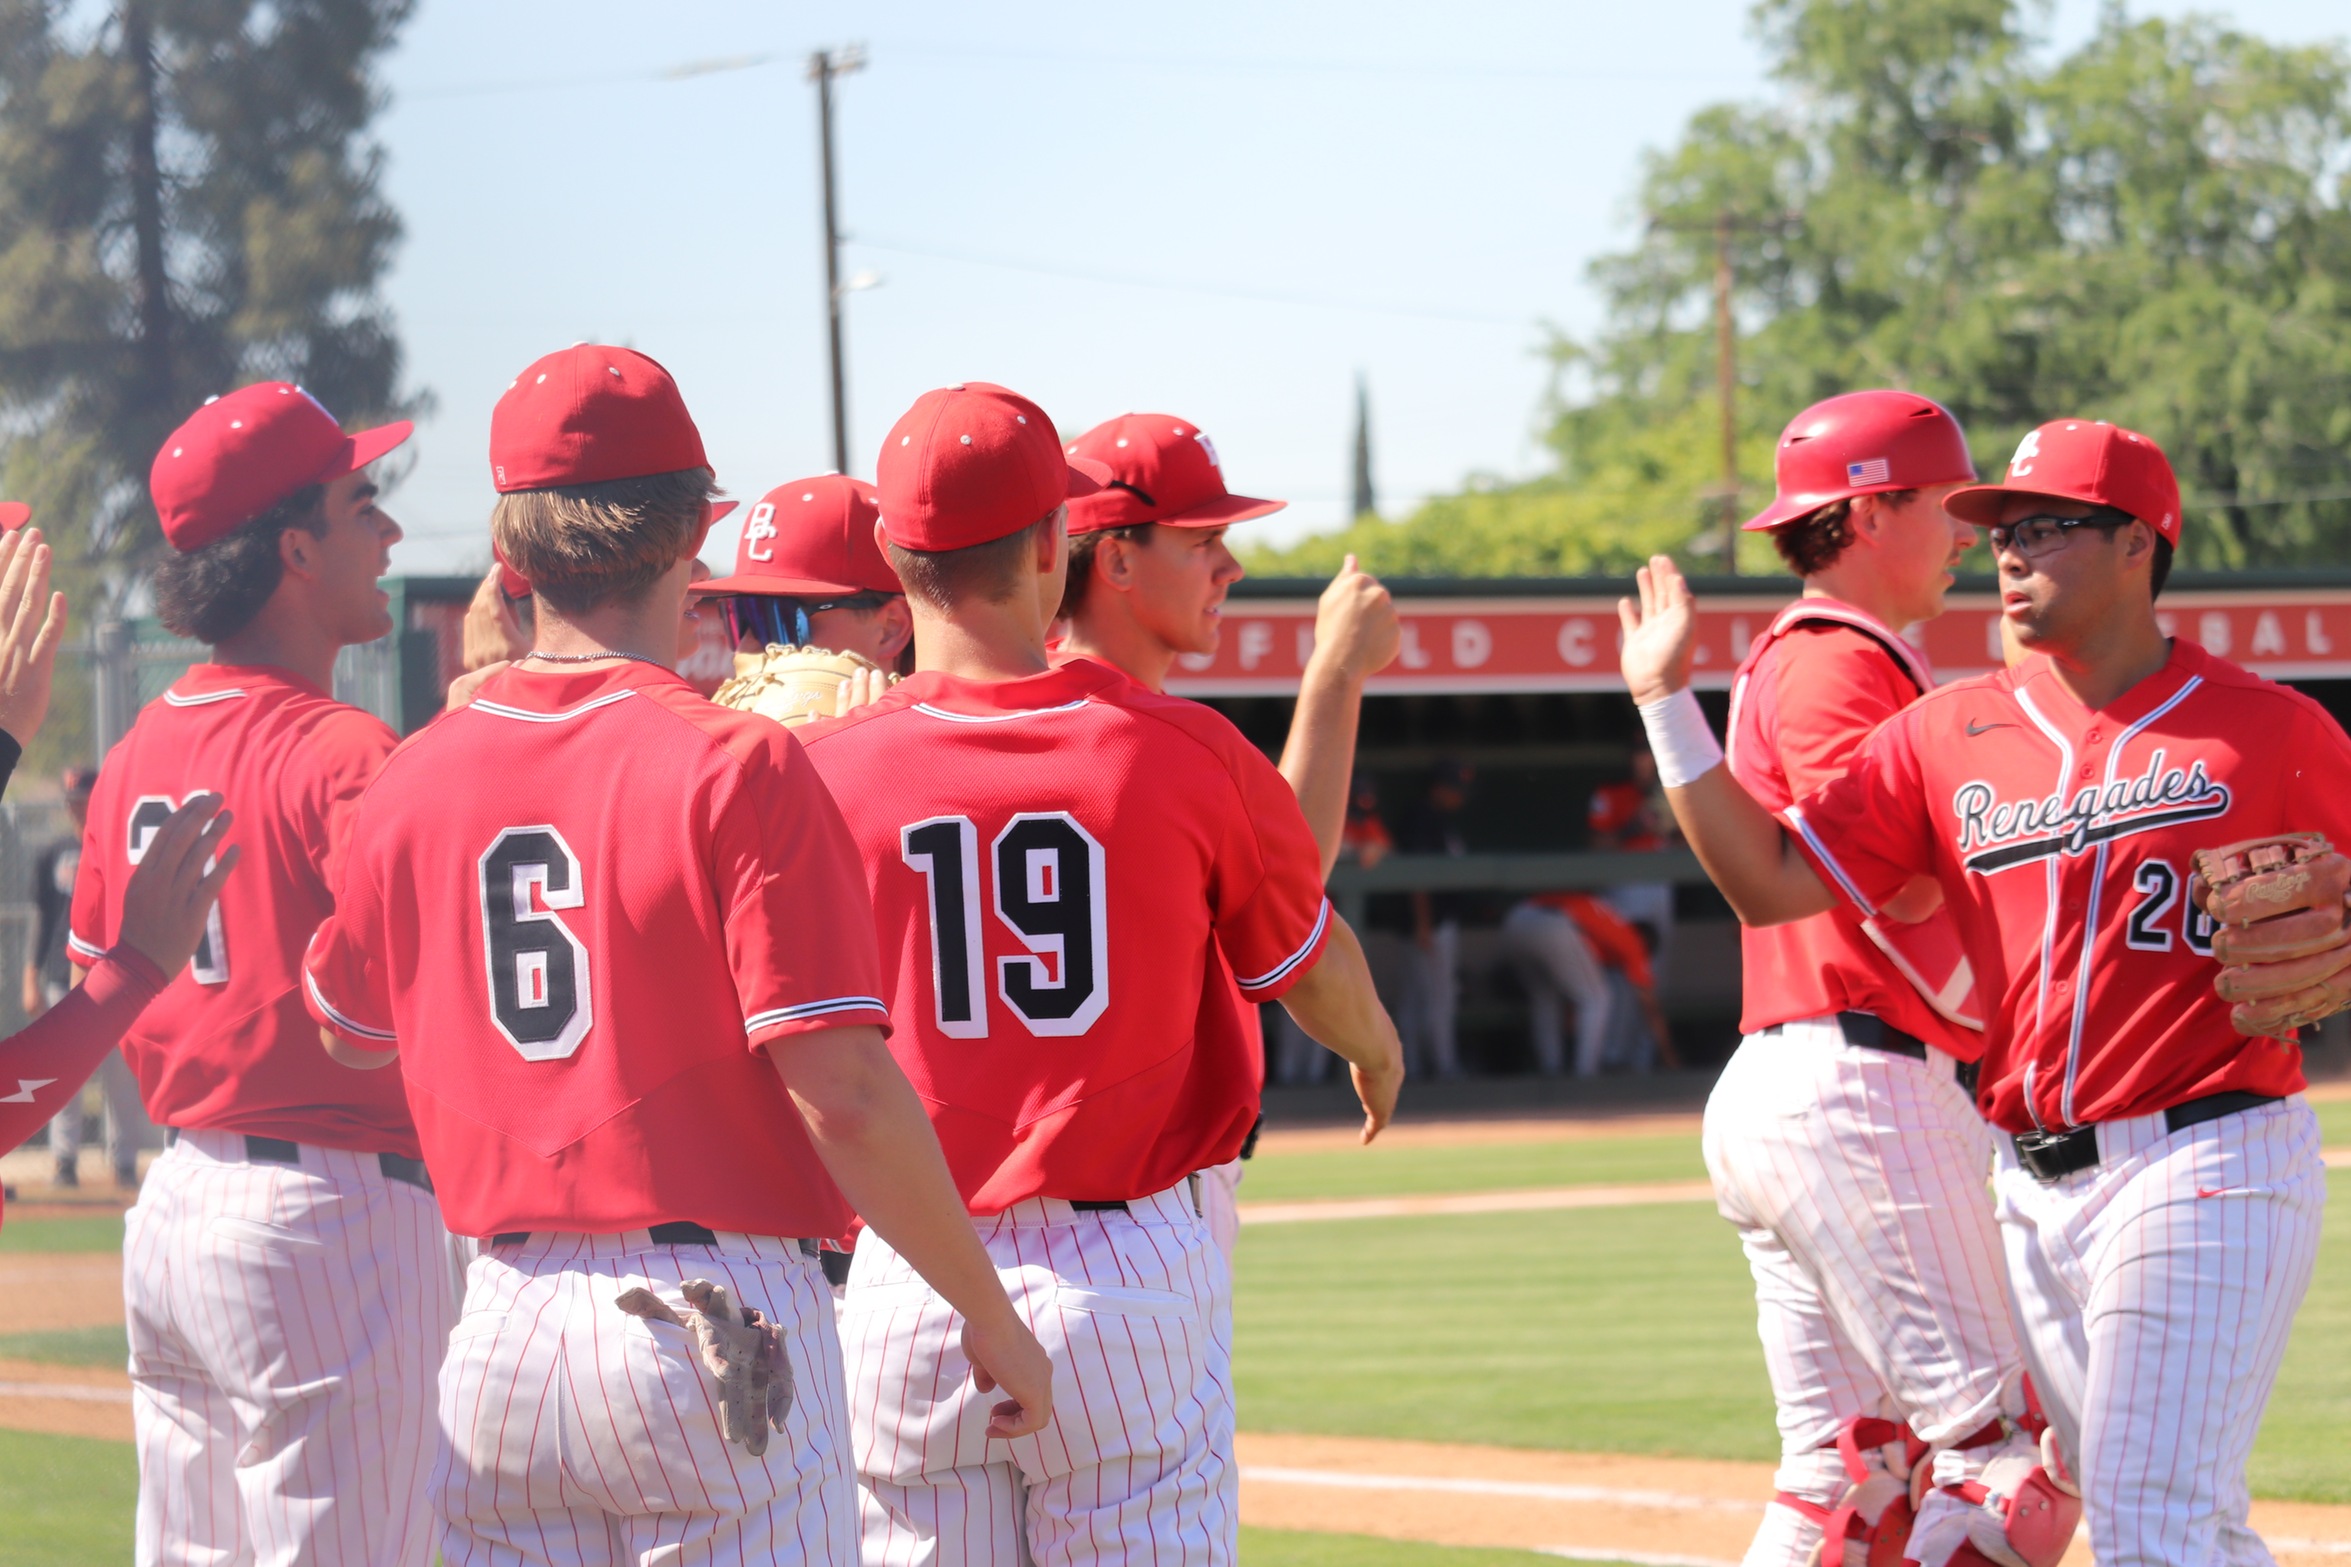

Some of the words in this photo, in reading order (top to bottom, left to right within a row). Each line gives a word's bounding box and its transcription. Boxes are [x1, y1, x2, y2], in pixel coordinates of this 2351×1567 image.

[744, 502, 778, 562] BC
[1953, 747, 2212, 858] Renegades
[478, 824, 593, 1062] 6
[900, 811, 1110, 1040] 19
